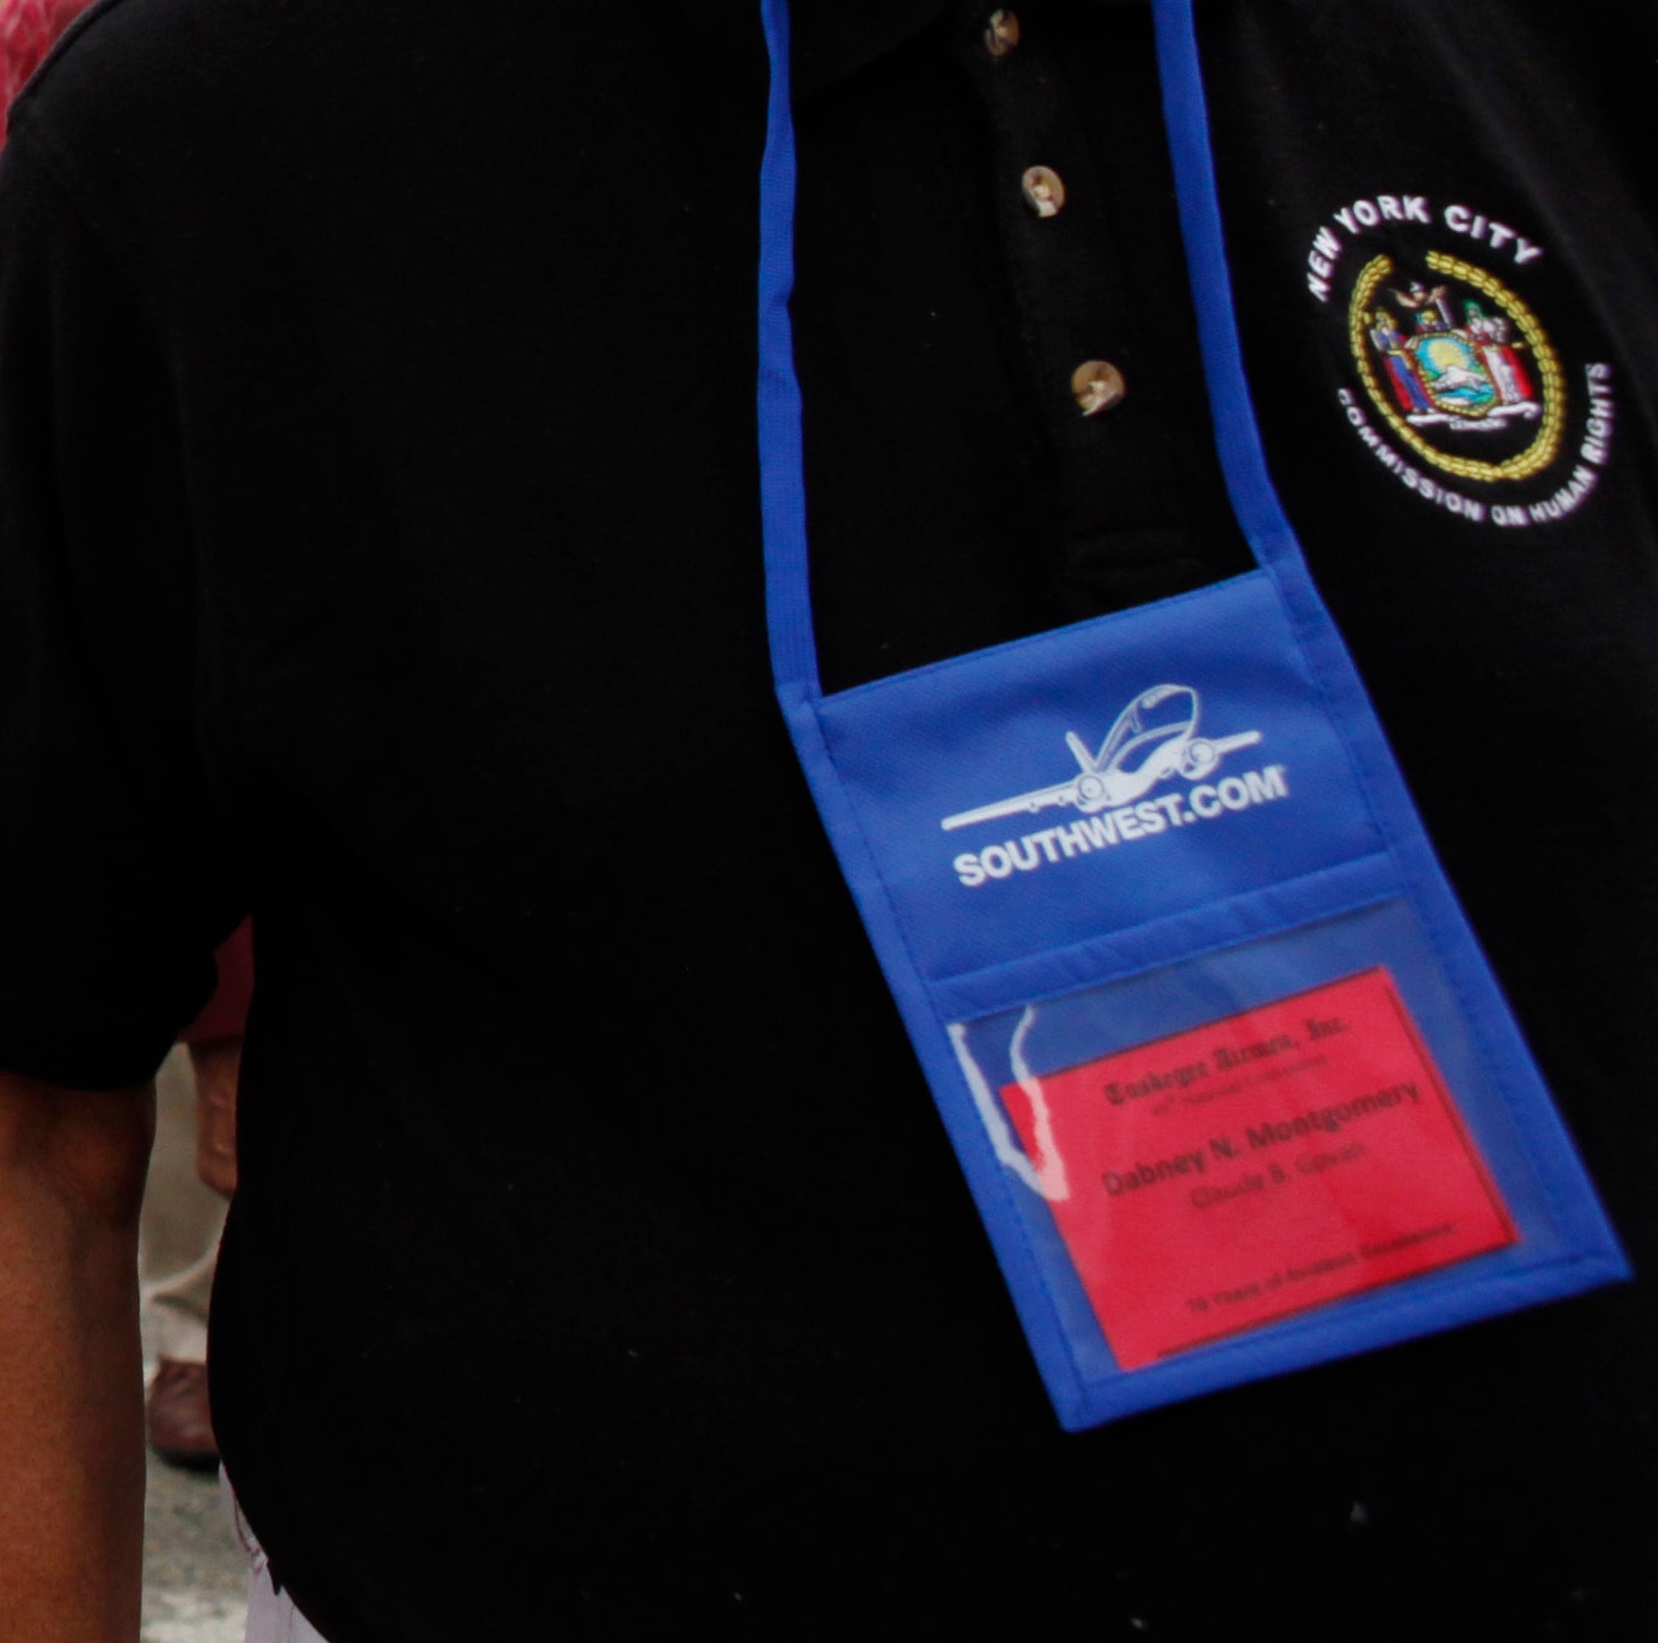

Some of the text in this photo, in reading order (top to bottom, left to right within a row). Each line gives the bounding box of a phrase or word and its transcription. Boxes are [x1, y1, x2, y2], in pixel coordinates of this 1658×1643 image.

[1306, 194, 1545, 304] NEW YORK CITY
[1337, 362, 1613, 528] COMMISSION ON HUMAN RIGHTS
[952, 764, 1289, 889] SOUTHWEST.COM
[1101, 1149, 1206, 1197] Dabney
[1245, 1081, 1421, 1149] Montgomery
